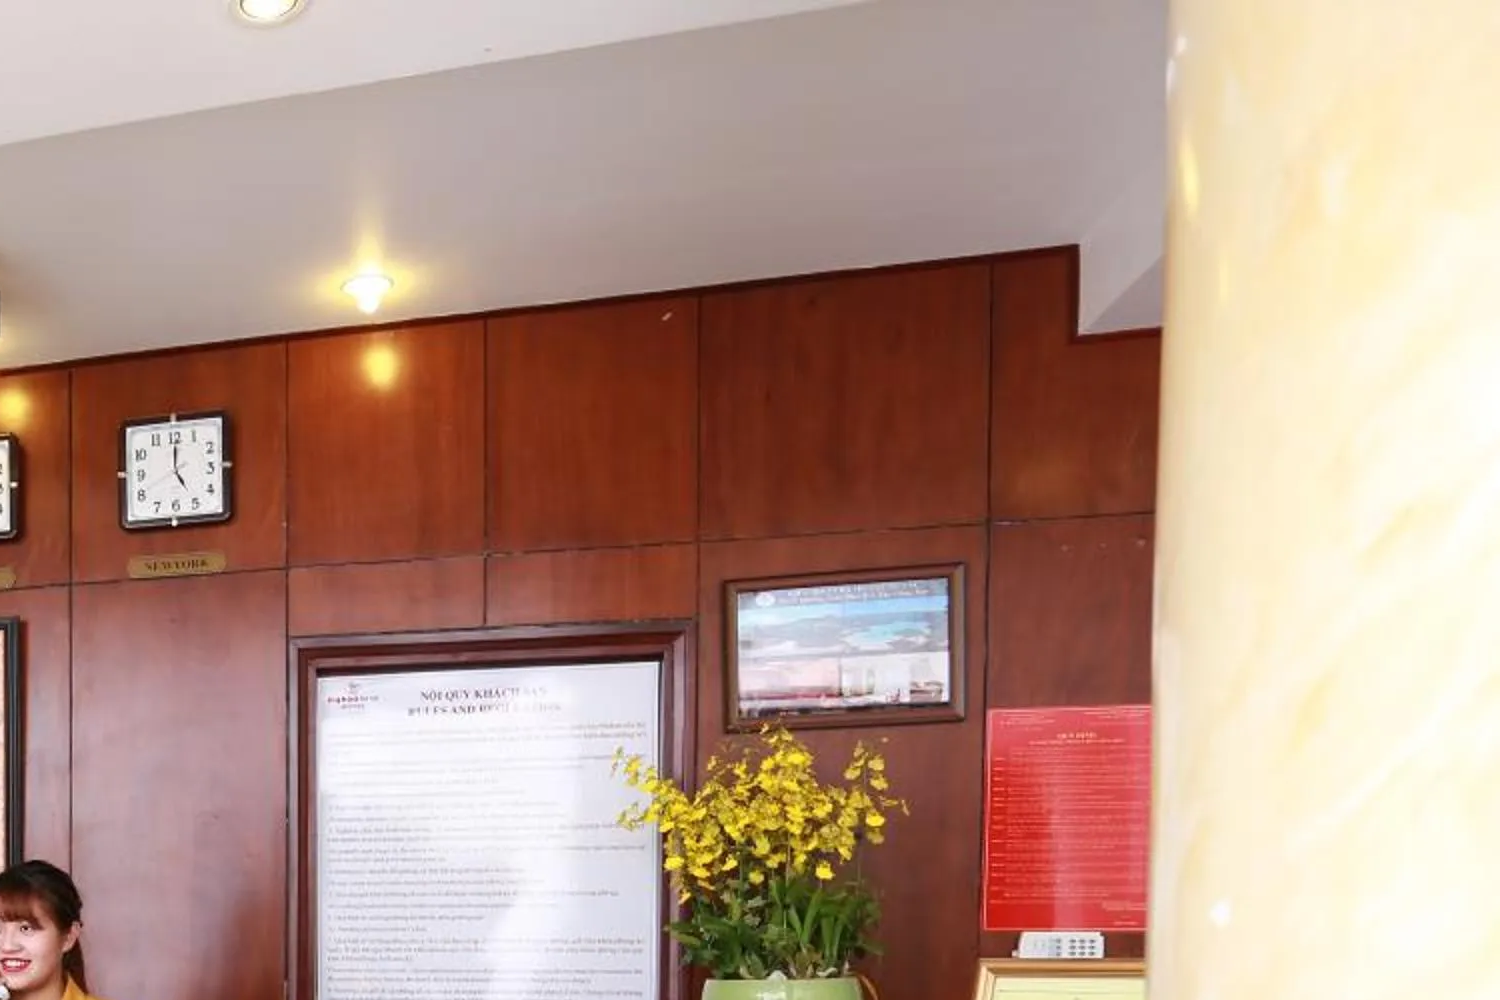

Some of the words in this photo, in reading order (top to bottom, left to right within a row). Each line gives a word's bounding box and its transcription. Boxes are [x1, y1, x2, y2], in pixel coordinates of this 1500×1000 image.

[151, 433, 161, 447] 11
[169, 431, 181, 445] 12
[205, 441, 214, 454] 2
[135, 448, 147, 462] 10
[206, 462, 215, 475] 3
[137, 469, 146, 482] 9
[137, 489, 147, 502] 8
[206, 484, 215, 495] 4
[153, 501, 161, 513] 7
[171, 499, 181, 512] 6
[191, 497, 200, 510] 5
[445, 688, 470, 702] QUY
[452, 704, 476, 715] AND
